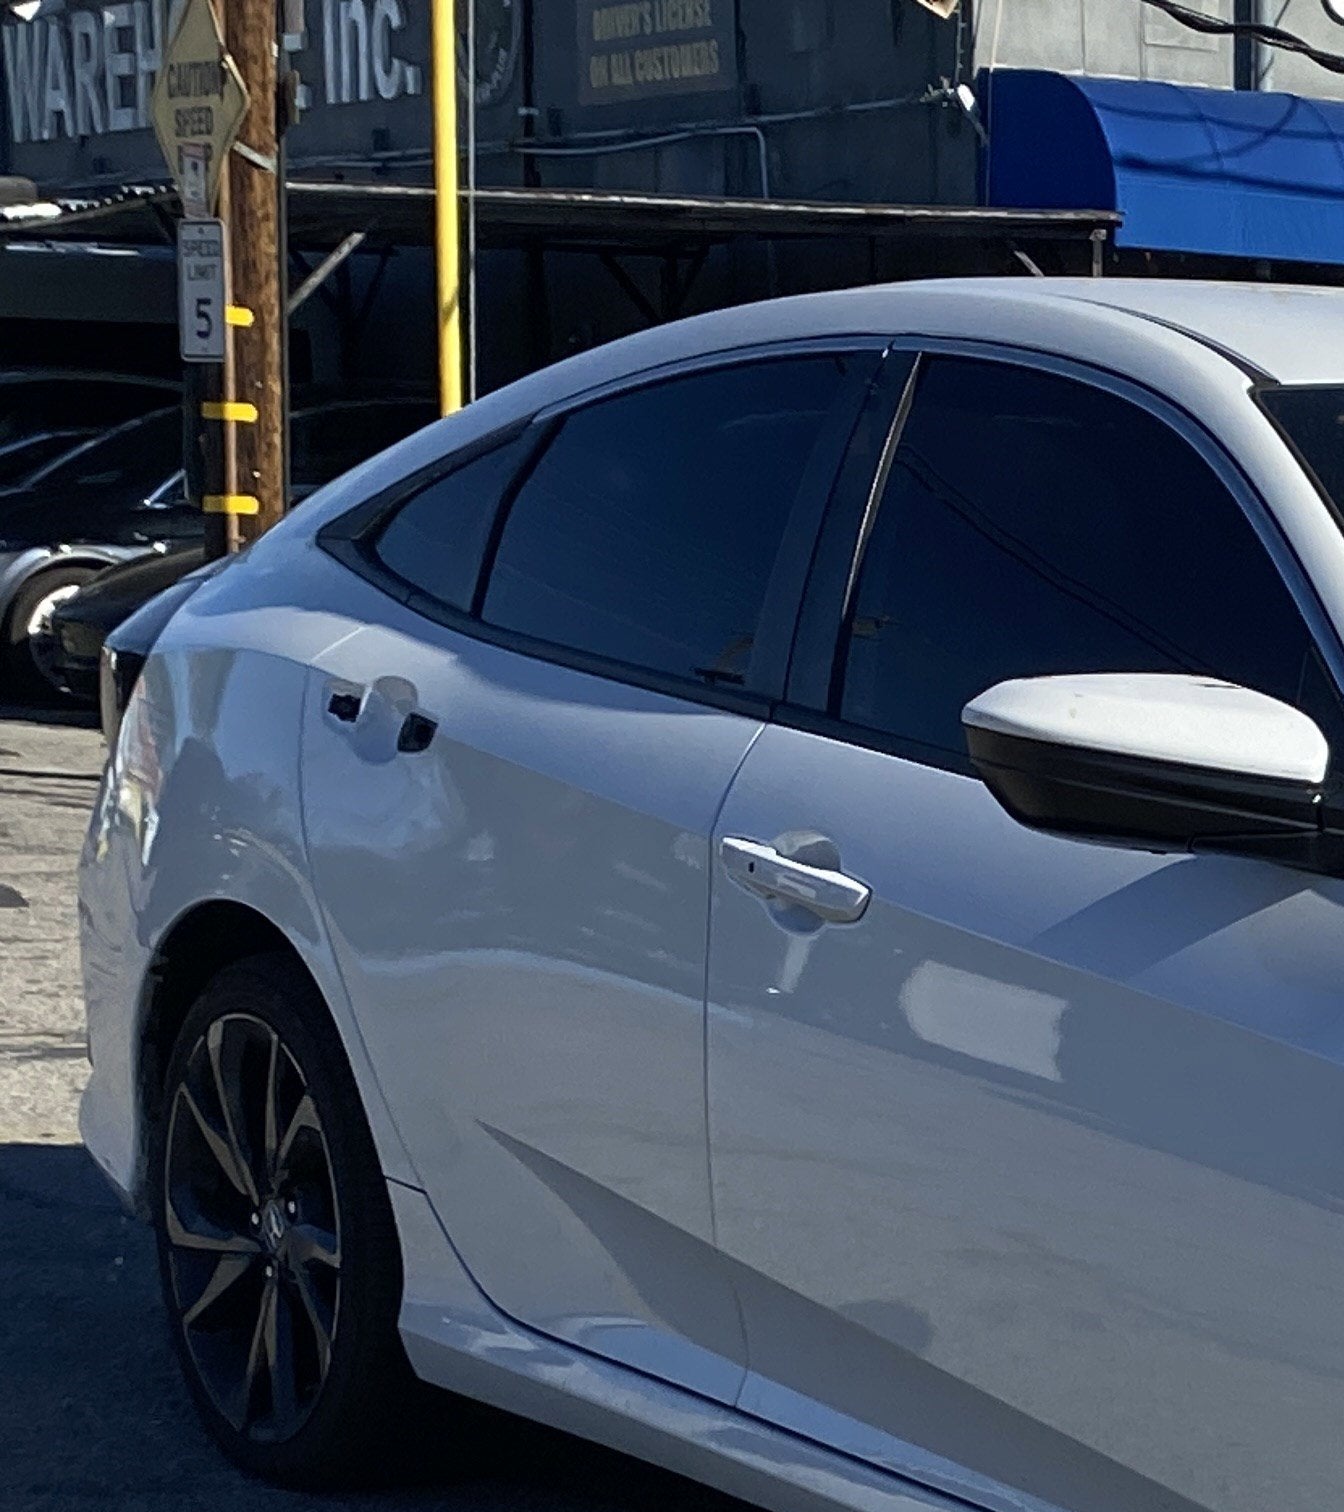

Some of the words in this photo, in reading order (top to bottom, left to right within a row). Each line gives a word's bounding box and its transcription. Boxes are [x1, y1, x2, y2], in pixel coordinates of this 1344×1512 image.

[175, 105, 214, 137] SPEED
[182, 239, 221, 257] SPEED
[187, 263, 216, 281] LIMIT
[195, 298, 212, 339] 5
